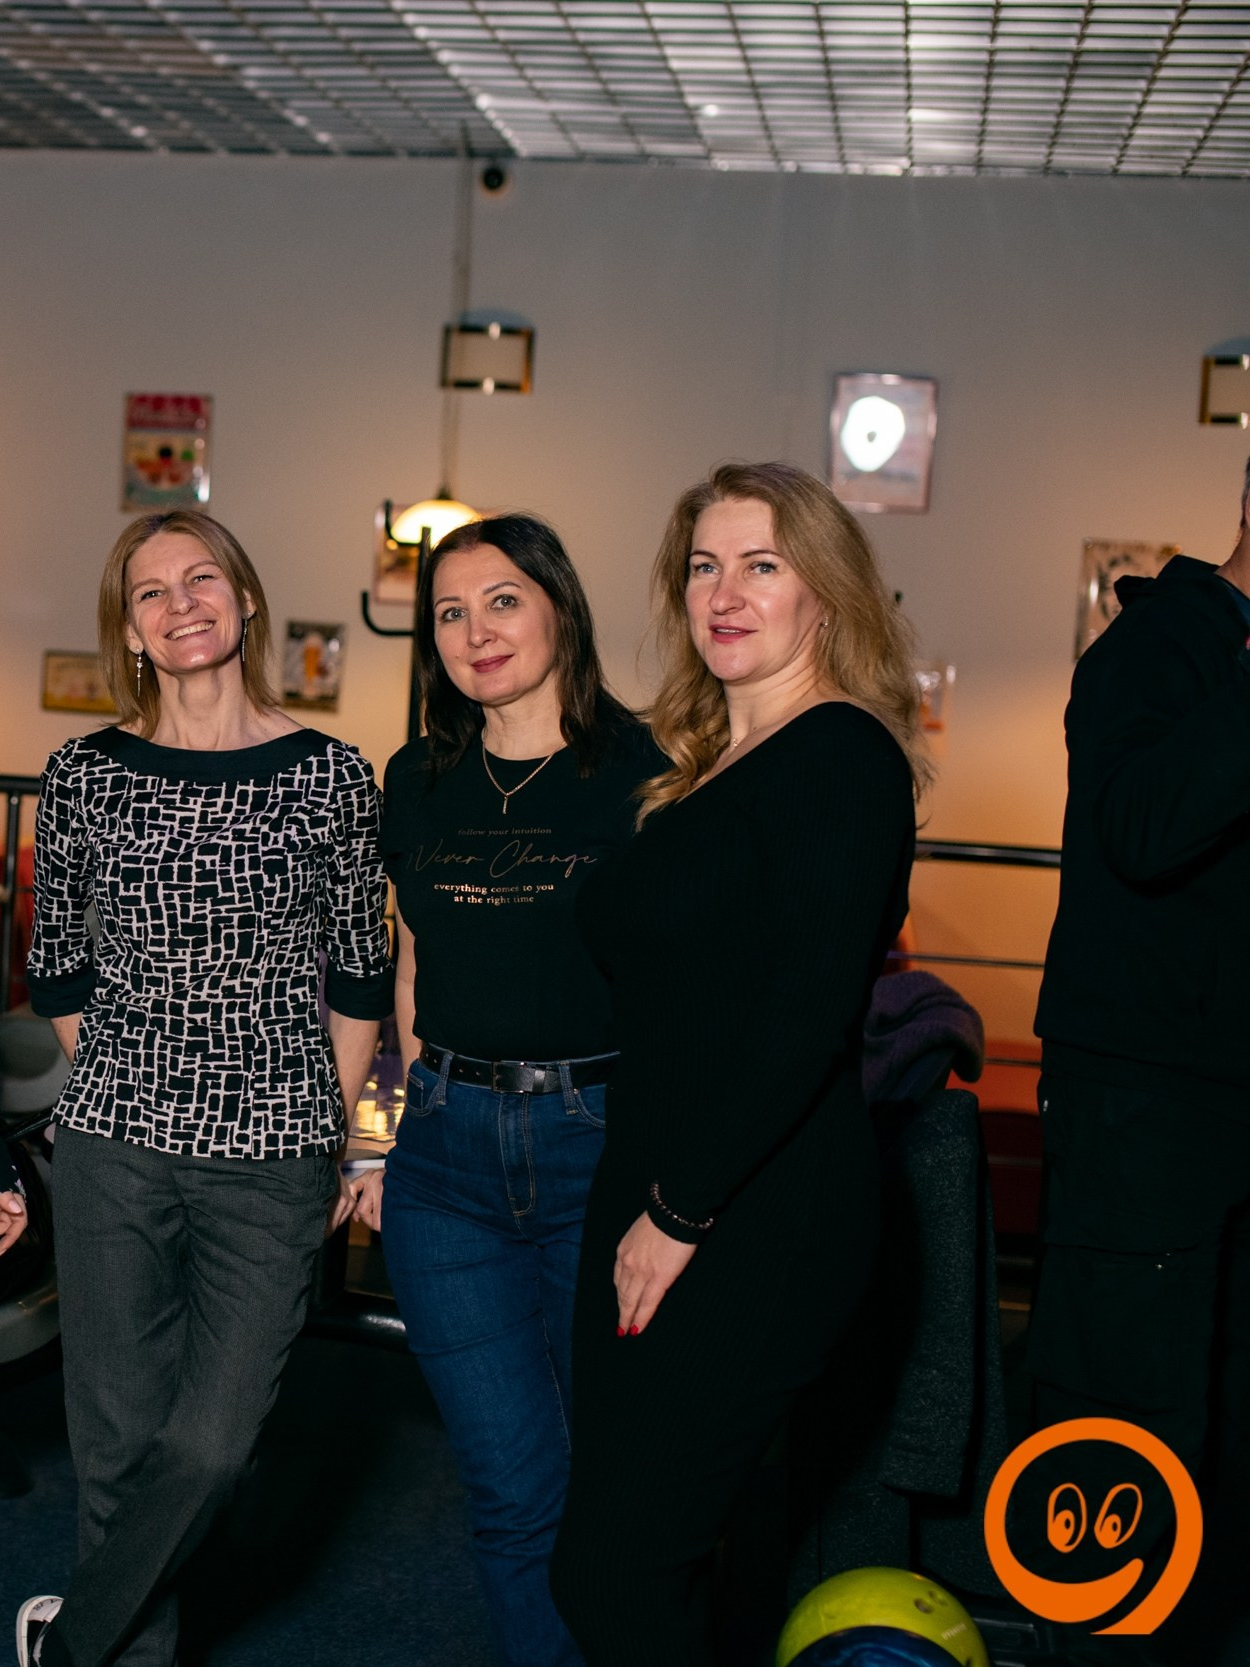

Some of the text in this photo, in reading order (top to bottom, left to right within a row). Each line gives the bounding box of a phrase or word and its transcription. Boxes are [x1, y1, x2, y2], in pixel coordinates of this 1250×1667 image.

[457, 827, 552, 837] follow your intuition
[406, 838, 599, 879] Never Change
[433, 883, 488, 896] everything
[536, 884, 555, 893] you
[453, 895, 535, 906] at the right time
